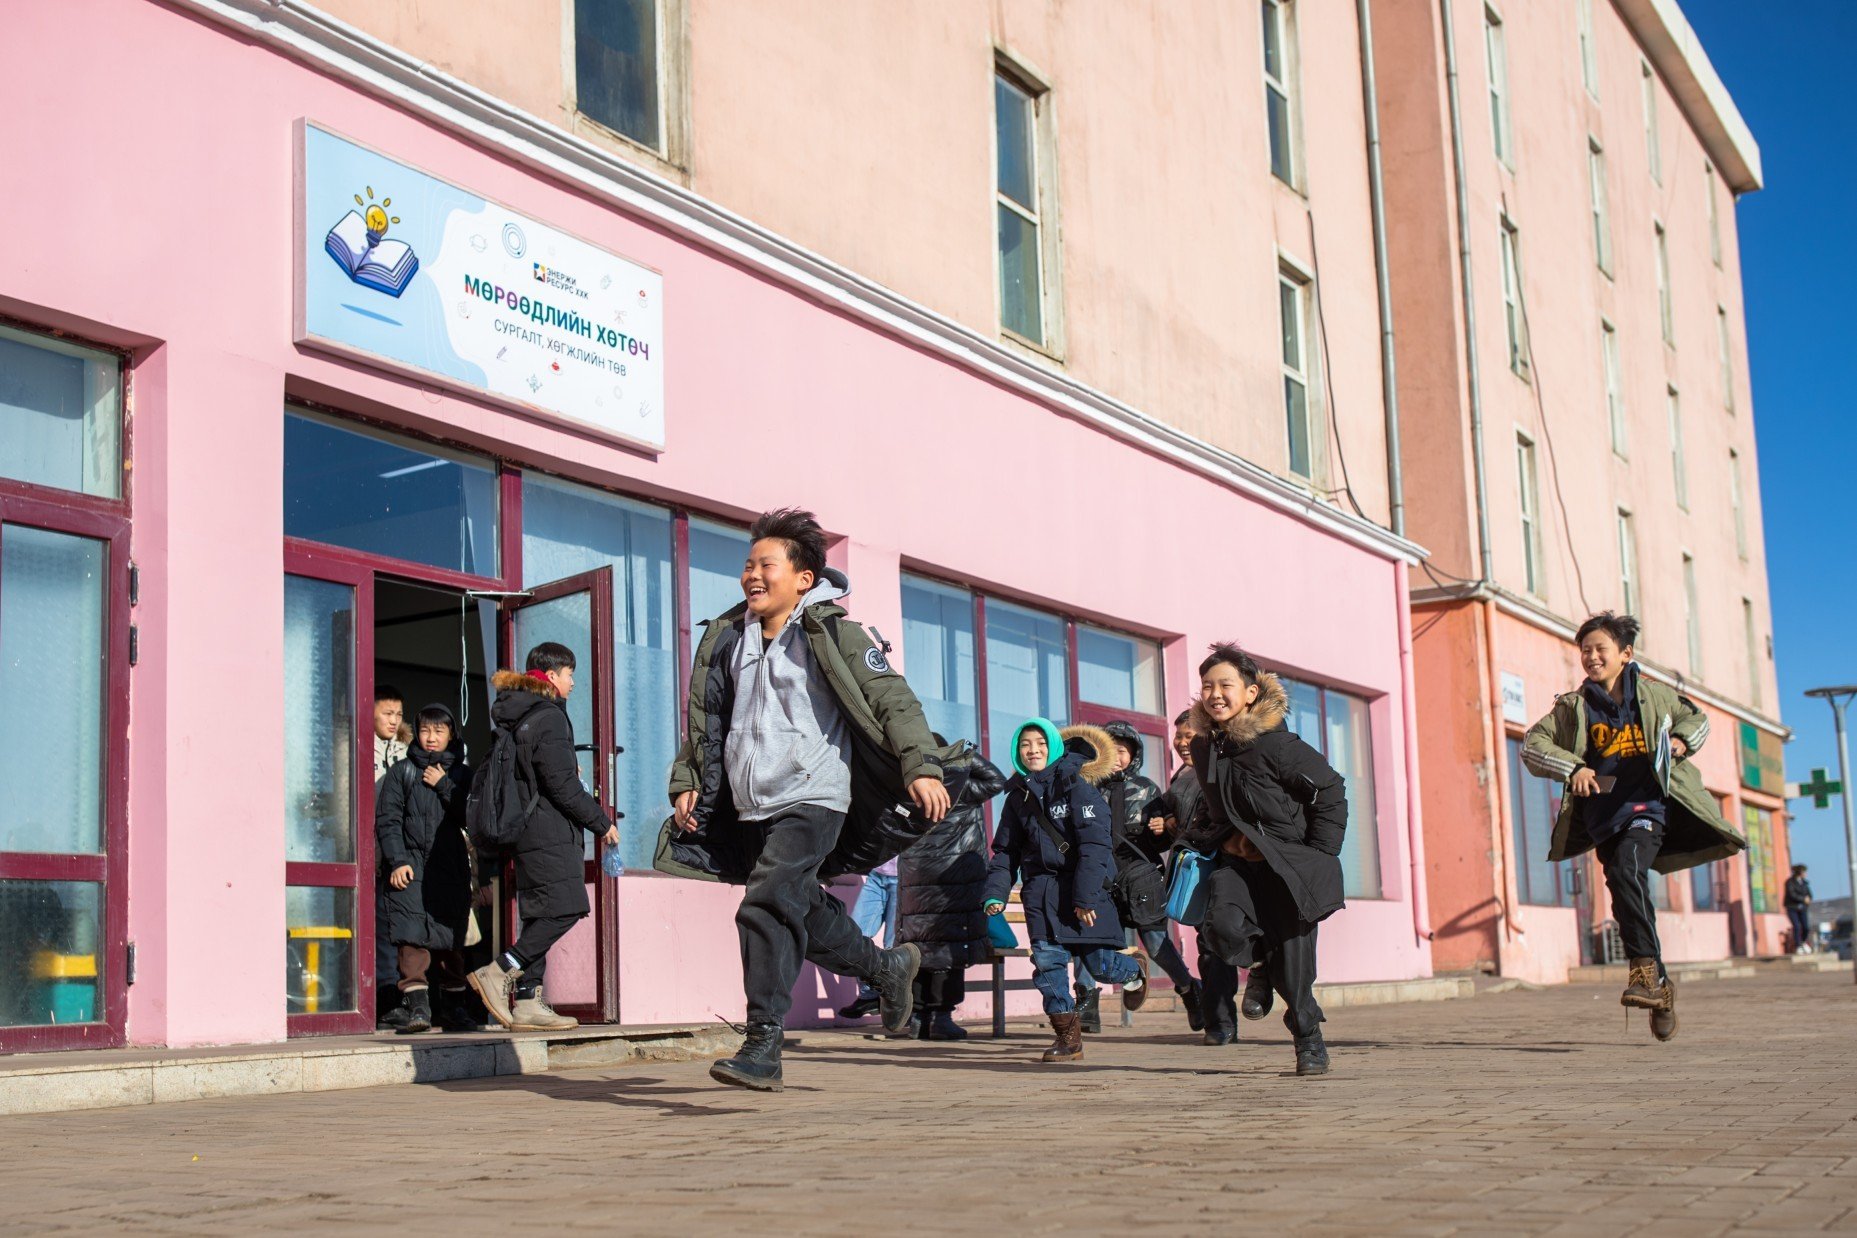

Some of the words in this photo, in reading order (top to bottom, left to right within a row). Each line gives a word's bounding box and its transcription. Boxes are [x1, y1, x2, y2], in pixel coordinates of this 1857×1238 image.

[547, 268, 576, 285] ЭНЕРЖИ
[547, 277, 574, 294] РЕСУРС
[575, 288, 589, 300] ХХК
[464, 274, 592, 339] МӨРӨӨДЛИЙН
[596, 324, 649, 360] ХӨТӨЧ
[494, 318, 545, 349] СУРГАЛТ,
[546, 337, 606, 369] ХӨГЖЛИЙН
[607, 359, 627, 377] ТӨВ
